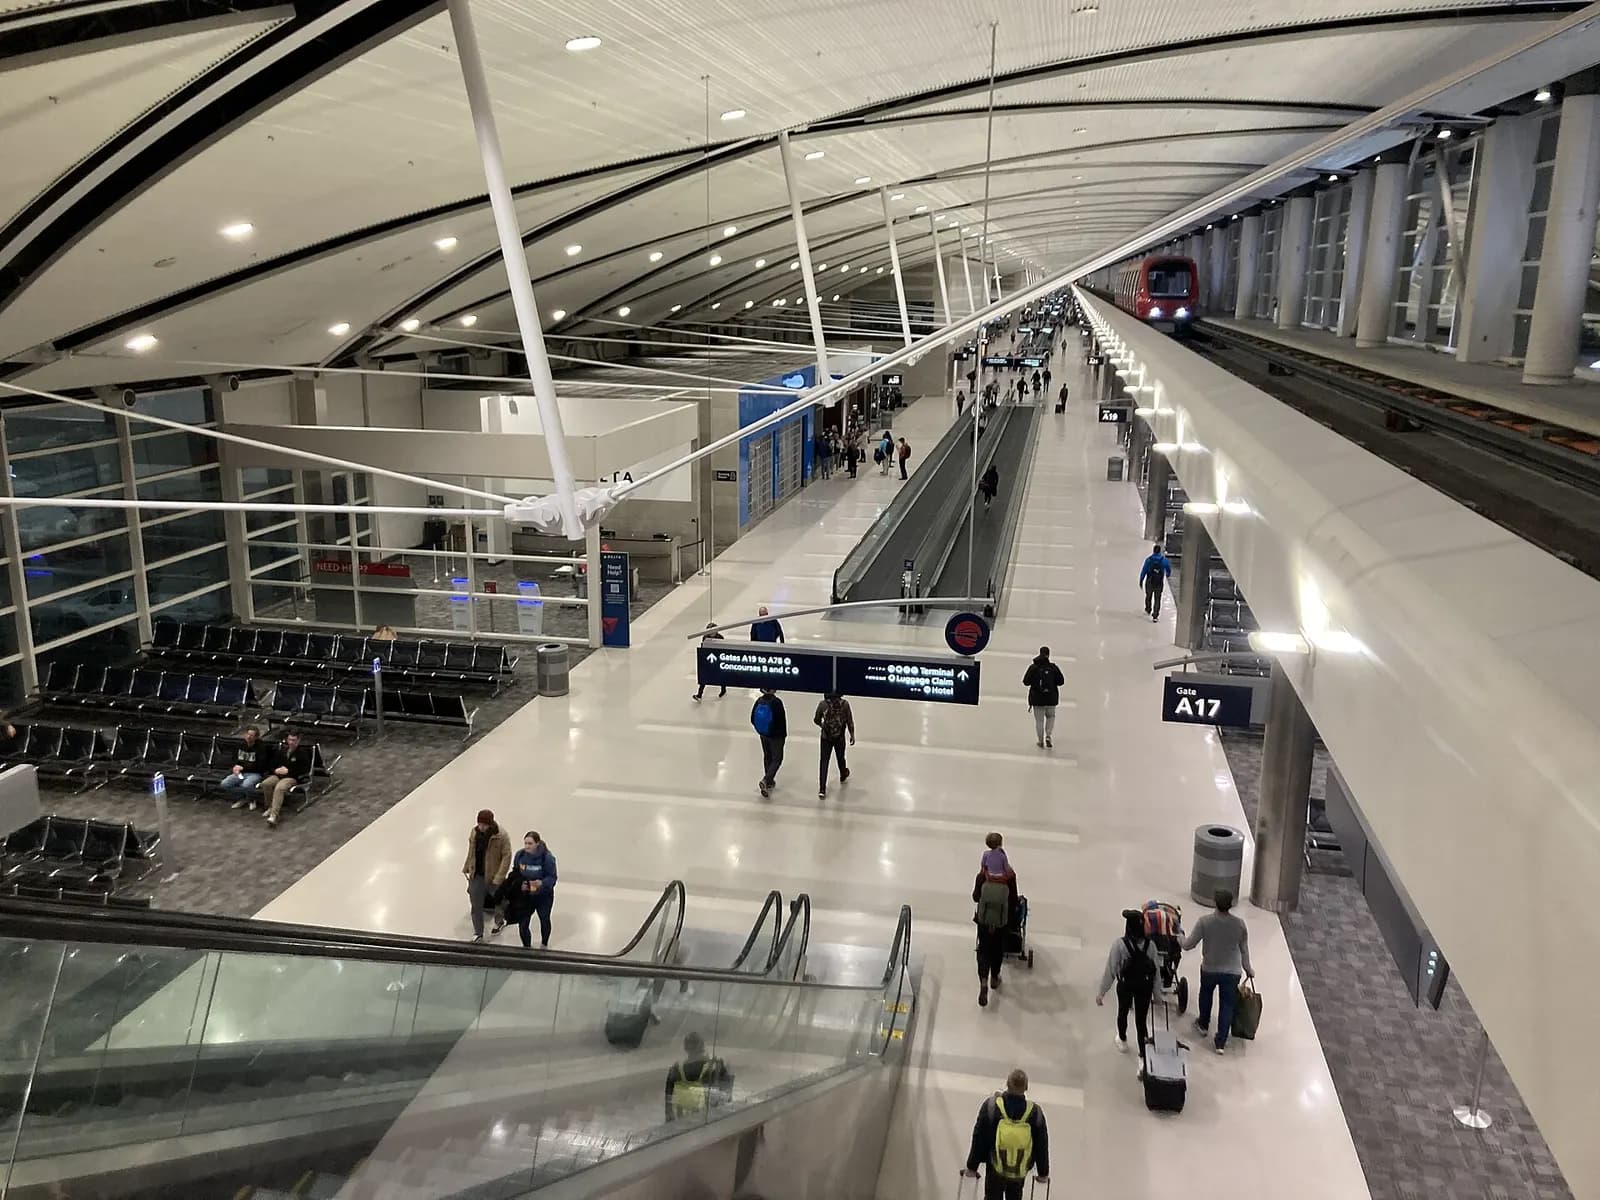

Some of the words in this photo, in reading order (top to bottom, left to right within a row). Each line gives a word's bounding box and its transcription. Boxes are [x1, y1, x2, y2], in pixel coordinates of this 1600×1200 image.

[1102, 412, 1118, 421] A19
[316, 562, 340, 572] NEED
[719, 653, 741, 662] Gates
[742, 655, 757, 663] A19
[719, 662, 761, 672] Concourses
[769, 666, 784, 674] and
[920, 667, 954, 677] Terminal
[896, 675, 930, 686] Luggage
[931, 677, 954, 686] Claim
[932, 687, 954, 696] Hotel
[1176, 687, 1197, 696] Gate
[1174, 697, 1221, 717] A17
